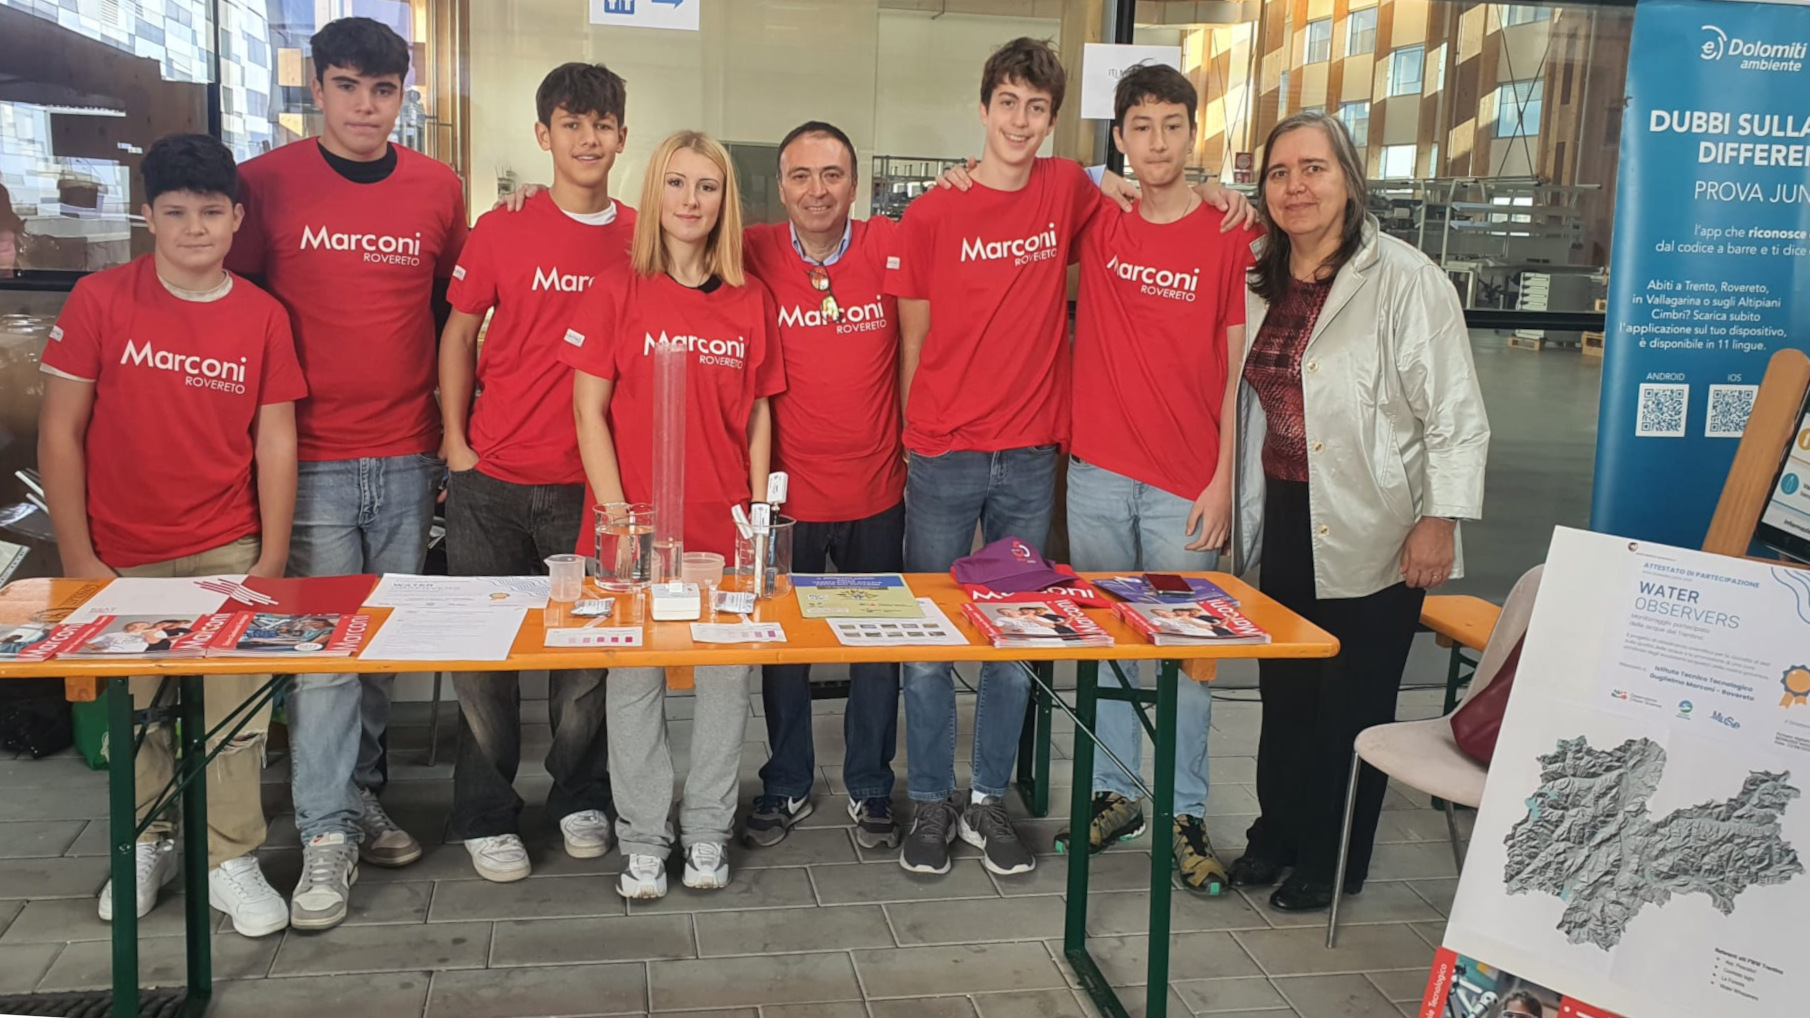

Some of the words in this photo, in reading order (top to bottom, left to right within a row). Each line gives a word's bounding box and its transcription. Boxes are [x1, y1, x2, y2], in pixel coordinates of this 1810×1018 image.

[1728, 39, 1807, 59] Dolomiti
[1740, 59, 1802, 71] ambiente
[1650, 110, 1731, 134] DUBBI
[1694, 180, 1764, 202] PROVA
[300, 224, 420, 255] Marconi
[1694, 224, 1722, 240] l'app
[1724, 226, 1745, 237] che
[1748, 227, 1807, 239] riconosce
[960, 223, 1056, 261] Marconi
[1655, 240, 1675, 252] dal
[1678, 242, 1714, 253] codice
[1717, 246, 1724, 254] a
[1727, 242, 1757, 255] barre
[1771, 244, 1779, 255] ti
[1782, 244, 1806, 256] dice
[363, 252, 420, 266] ROVERETO
[531, 265, 596, 292] Mar
[1647, 280, 1673, 290] Abiti
[1685, 280, 1718, 292] Trento,
[1721, 282, 1769, 294] Rovereto,
[1140, 285, 1196, 302] ROVERETO
[1632, 295, 1643, 304] in
[1646, 295, 1701, 308] Vallagarina
[1712, 297, 1736, 309] sugli
[1738, 297, 1781, 309] Altipiani
[1651, 309, 1690, 320] Cimbri?
[1693, 310, 1727, 320] Scarica
[1729, 311, 1760, 321] subito
[836, 320, 887, 335] ROVERETO
[1620, 322, 1692, 335] l'applicazione
[1694, 324, 1708, 335] sul
[1710, 325, 1726, 335] tuo
[1729, 326, 1787, 338] dispositivo,
[1639, 338, 1646, 348] è
[1650, 338, 1703, 350] disponibile
[1706, 340, 1715, 349] in
[1718, 339, 1729, 349] 11
[1732, 339, 1766, 352] lingue.
[120, 338, 247, 382] Marconi
[698, 355, 743, 369] ROVERETO
[185, 376, 245, 395] ROVERETO
[1646, 372, 1685, 380] ANDROID
[1643, 561, 1686, 575] ATTESTATO
[1695, 570, 1759, 588] PARTECIPAZIONE
[1640, 580, 1700, 604] WATER
[1634, 597, 1741, 629] OBSERVERS
[1649, 672, 1685, 686] Guglielmo
[1685, 680, 1715, 692] Marconi
[1721, 689, 1754, 701] Rovereto
[1680, 670, 1708, 682] Tecnico
[1708, 677, 1753, 692] Tecnologico
[1428, 963, 1448, 1008] Tecnologico
